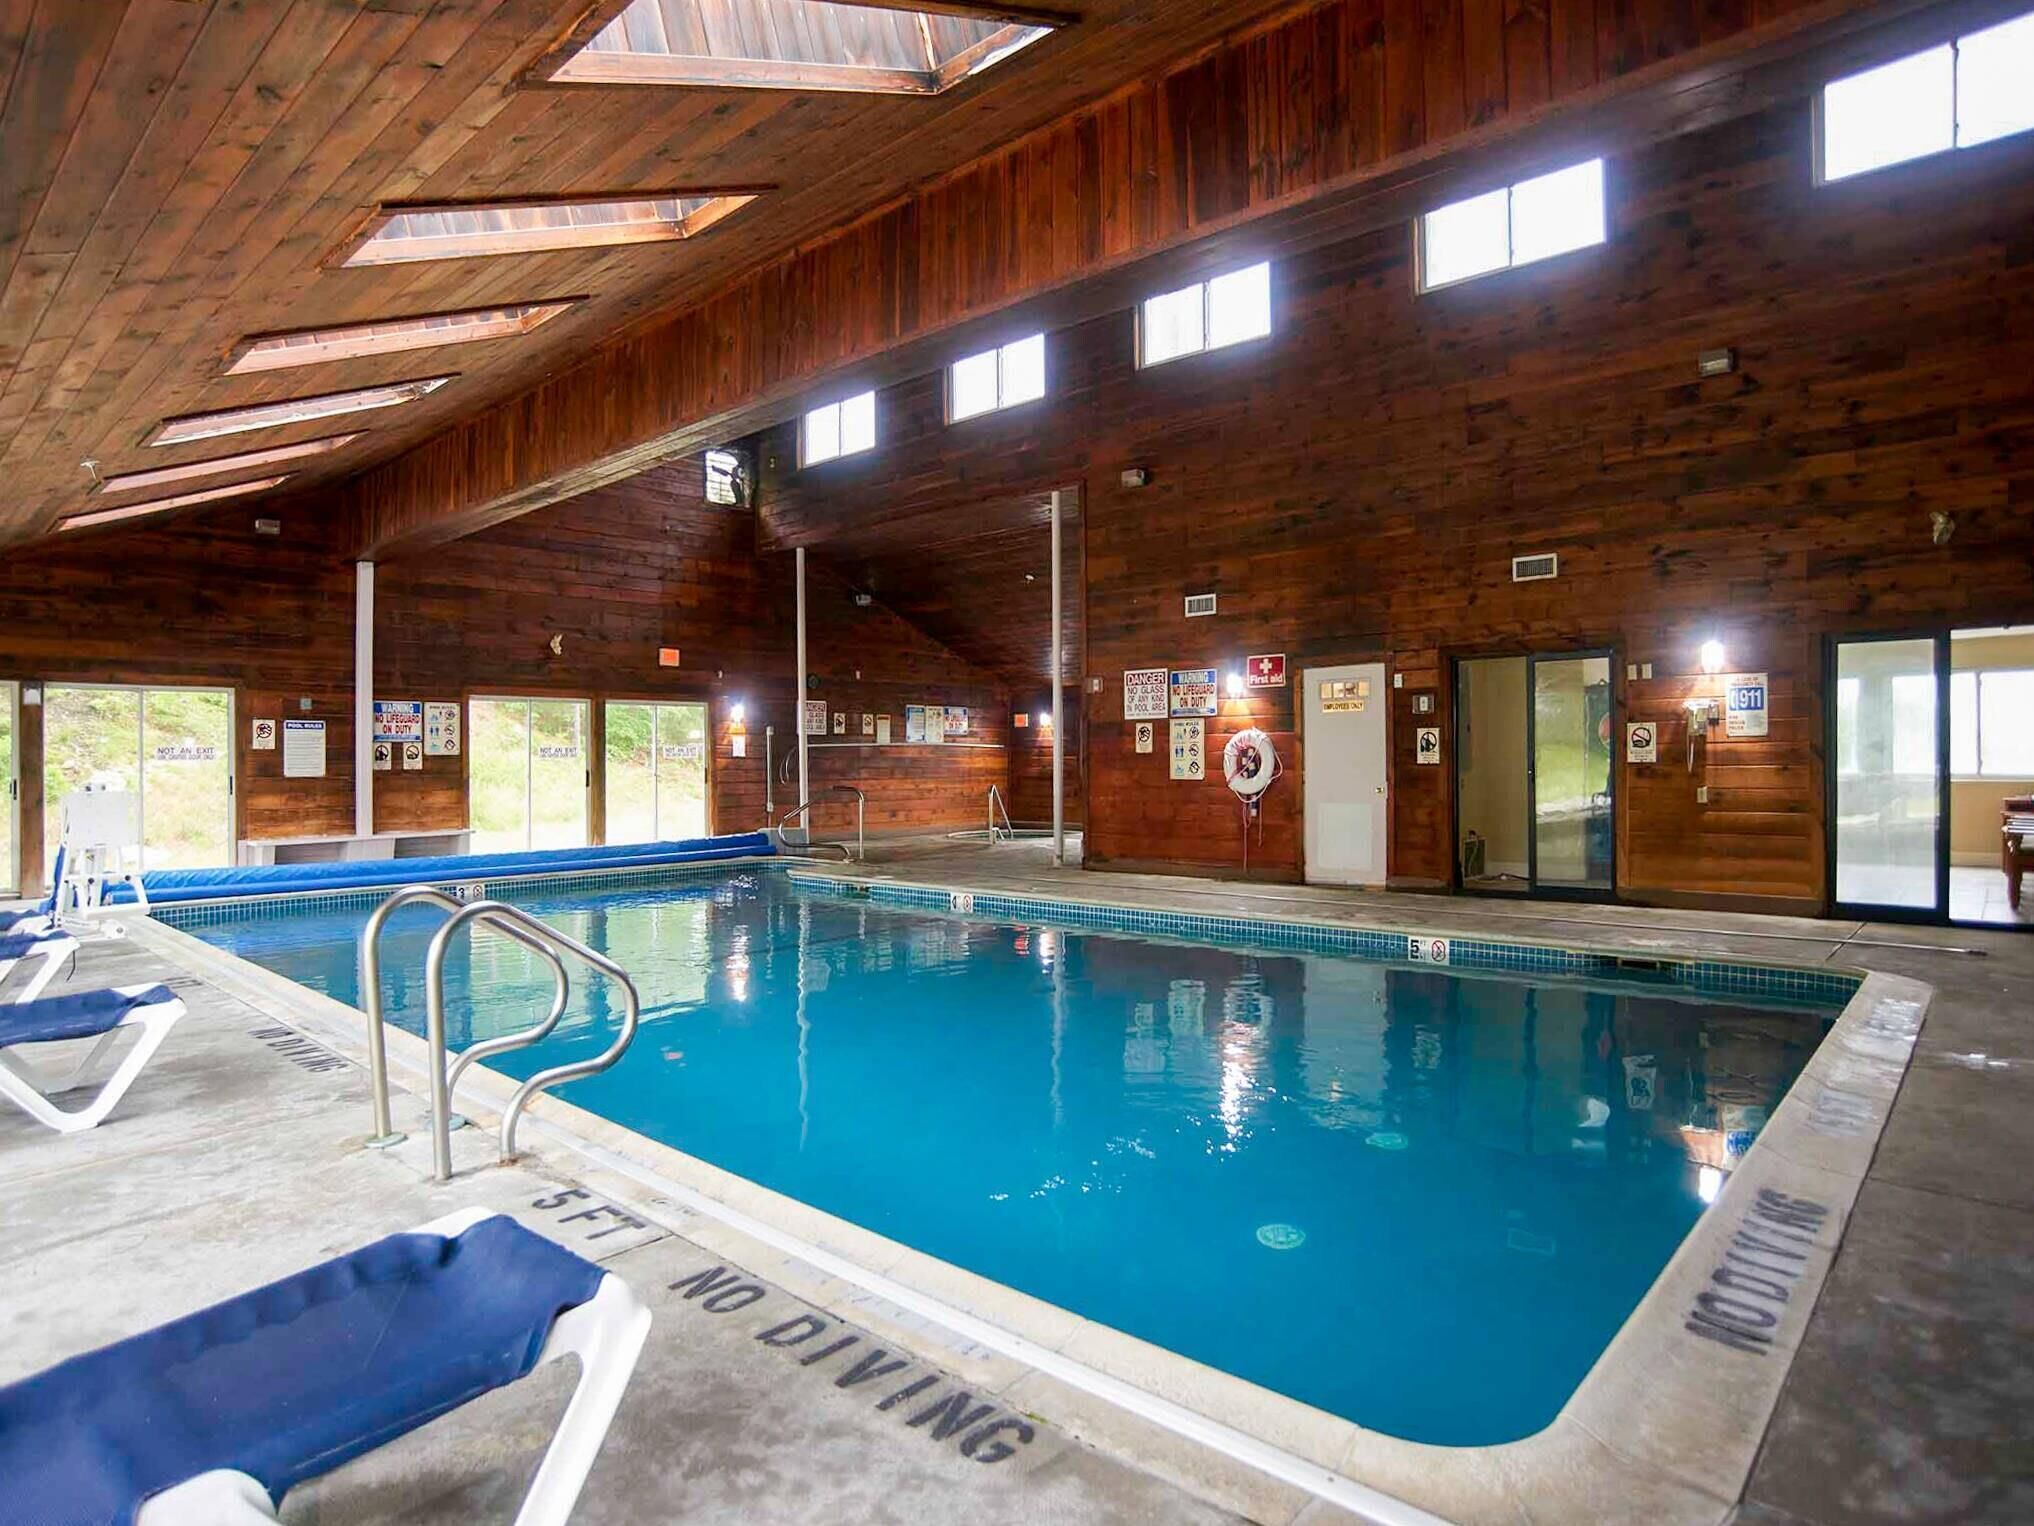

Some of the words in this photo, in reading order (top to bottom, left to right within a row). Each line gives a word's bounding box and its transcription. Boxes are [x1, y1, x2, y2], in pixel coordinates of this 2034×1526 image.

[1127, 673, 1165, 685] DANGER
[1178, 672, 1209, 685] WARNING
[1250, 674, 1269, 684] First
[1270, 673, 1283, 683] aid
[1127, 686, 1138, 695] NO
[1141, 685, 1165, 694] GLASS
[1172, 685, 1181, 696] NO
[1182, 684, 1215, 695] LIFEGUARD
[1127, 695, 1135, 703] OF
[1138, 695, 1148, 703] ANY
[1151, 694, 1165, 702] KIND
[1179, 697, 1188, 708] ON
[1191, 696, 1208, 707] DUTY
[1740, 689, 1761, 708] 911
[381, 703, 414, 713] WARNING
[1126, 705, 1133, 713] IN
[1135, 704, 1149, 712] POOL
[1151, 703, 1166, 711] AREA
[1323, 703, 1350, 711] EMPLOYEES
[1351, 702, 1363, 710] ONLY
[375, 714, 384, 723] NO
[386, 713, 420, 723] LIFEGUARD
[383, 724, 392, 734] ON
[395, 724, 412, 734] DUTY
[532, 1186, 591, 1211] 5
[558, 1203, 646, 1242] FT
[1712, 1188, 1829, 1304] DIVING
[1684, 1292, 1777, 1356] NO
[667, 1265, 767, 1313] NO
[755, 1314, 1035, 1464] DIVING
